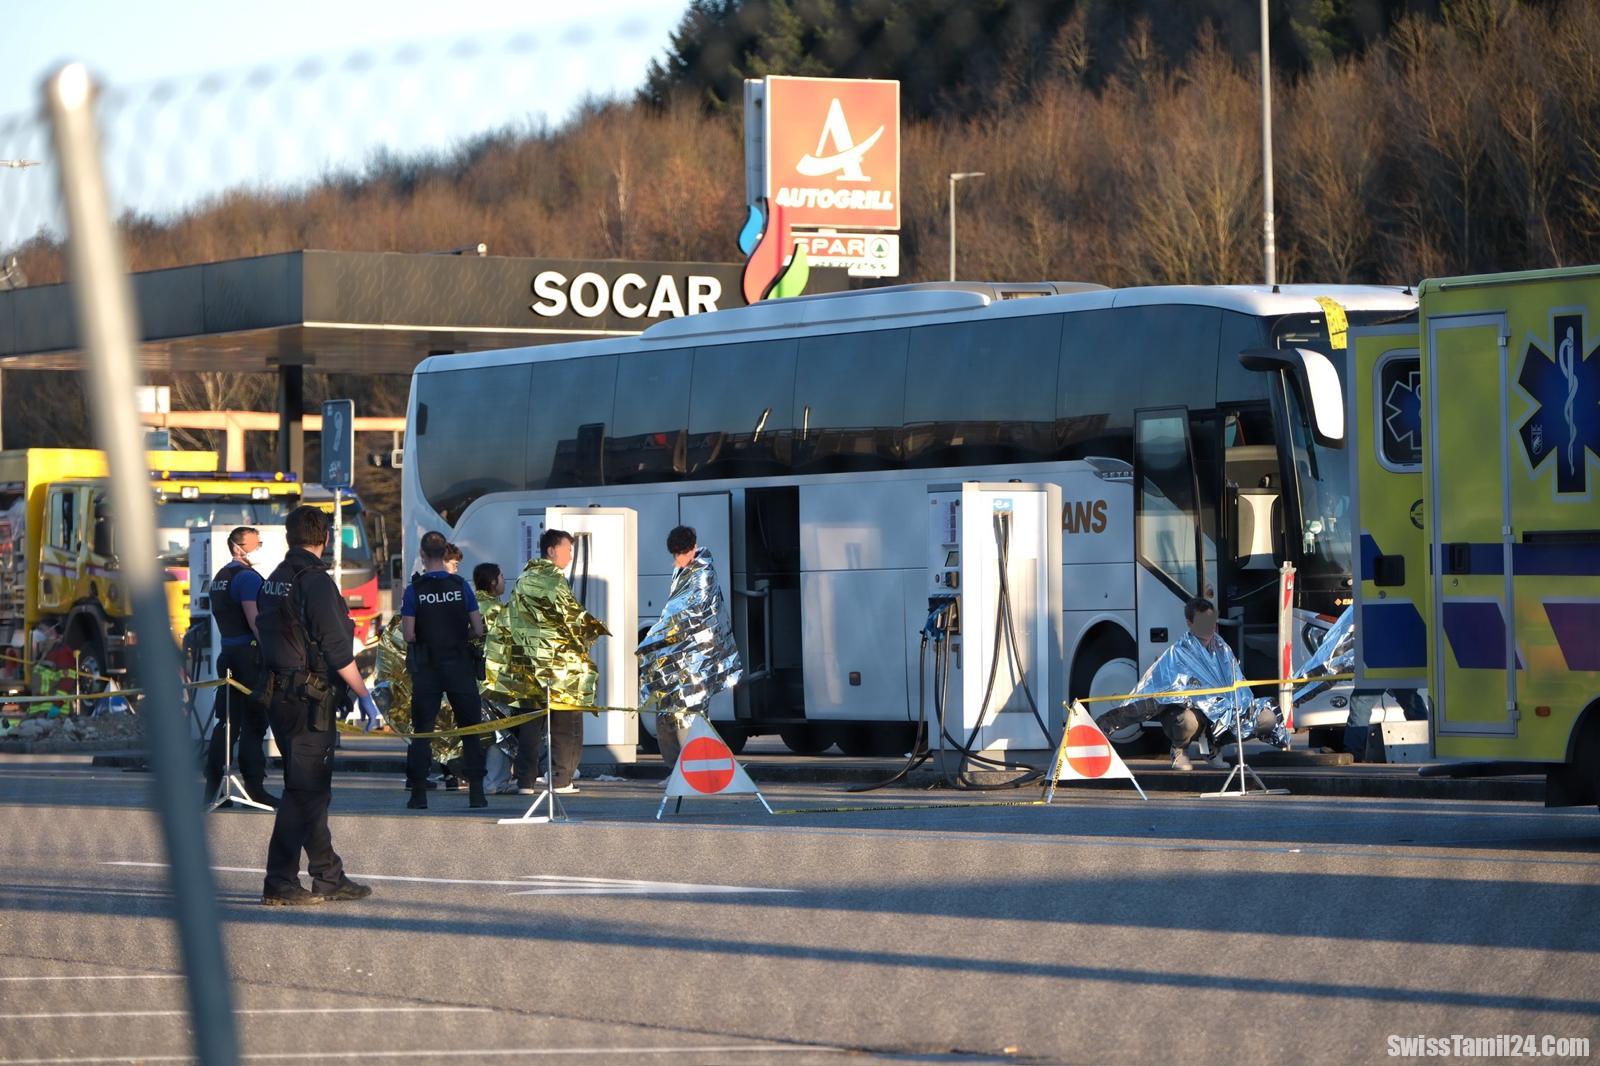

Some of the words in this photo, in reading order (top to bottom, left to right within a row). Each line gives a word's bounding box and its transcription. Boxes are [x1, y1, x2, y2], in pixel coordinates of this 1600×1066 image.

[775, 187, 894, 211] AUTOGRILL
[531, 270, 722, 319] SOCAR
[418, 590, 463, 605] POLICE
